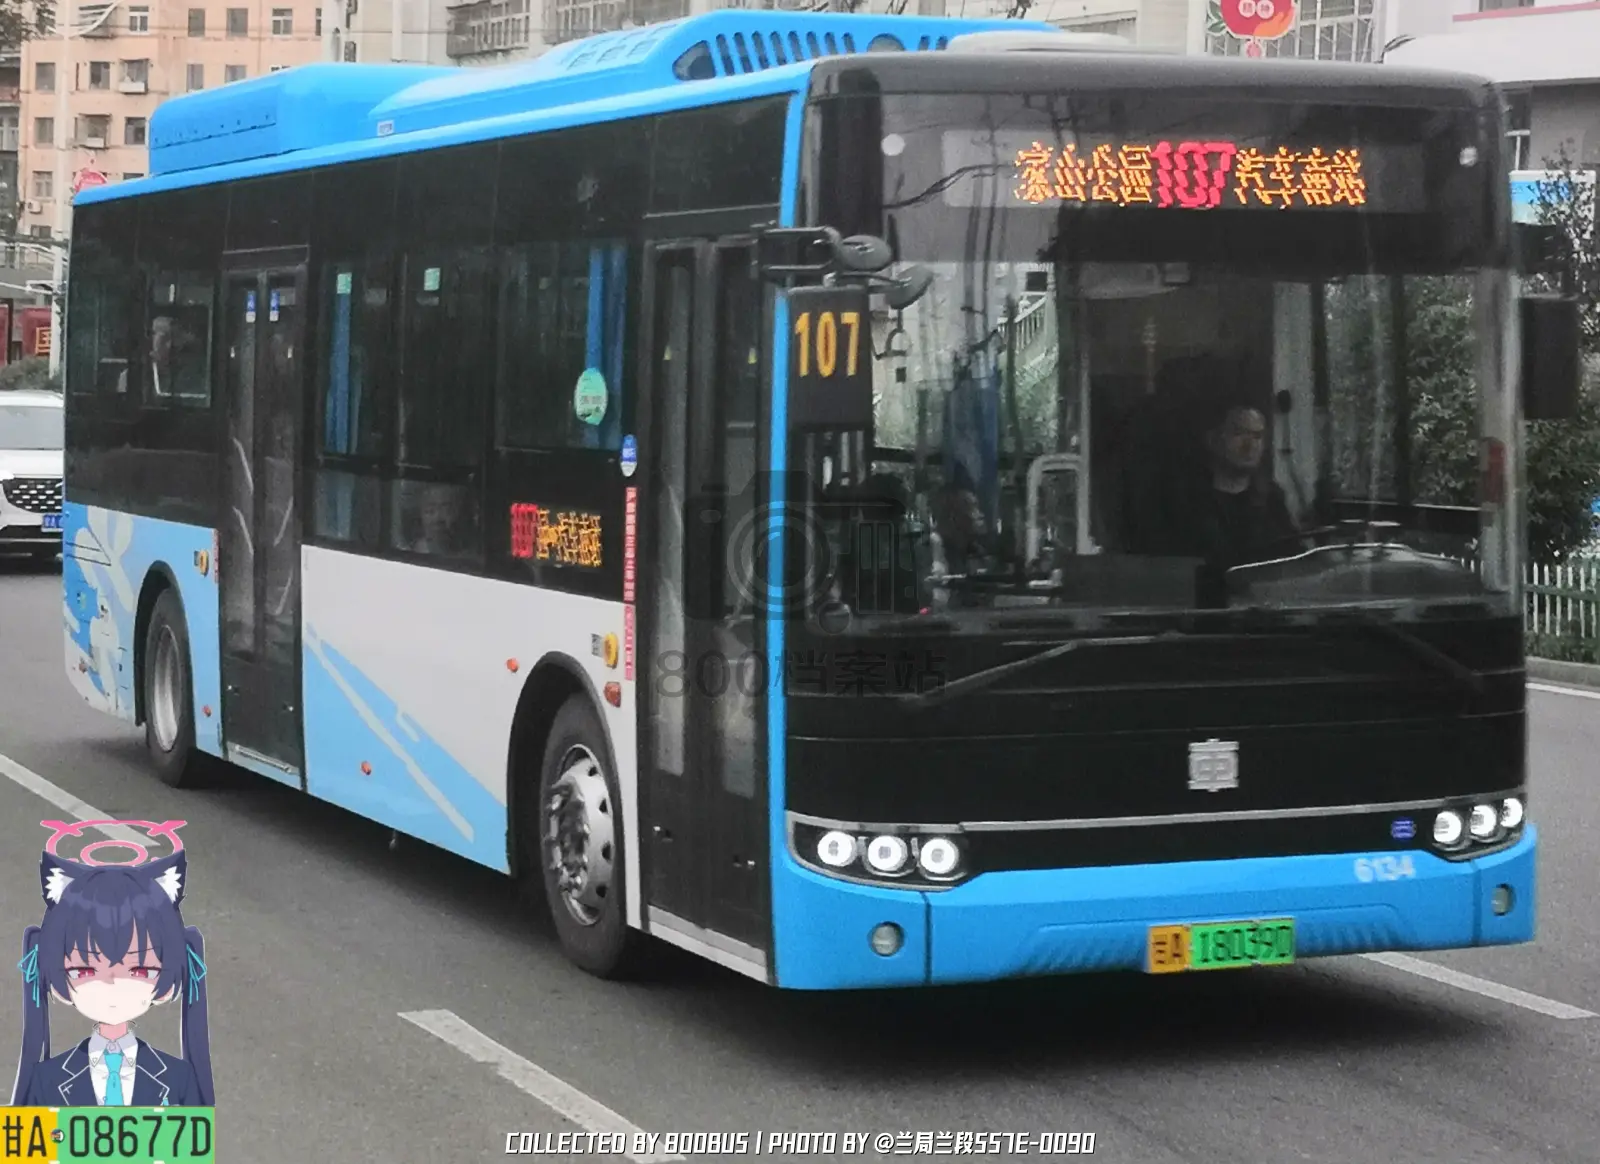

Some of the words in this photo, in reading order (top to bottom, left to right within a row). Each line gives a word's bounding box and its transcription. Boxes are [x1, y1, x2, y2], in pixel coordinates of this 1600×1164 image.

[1151, 141, 1237, 209] 107
[795, 311, 859, 377] 107
[1354, 855, 1416, 883] 6134
